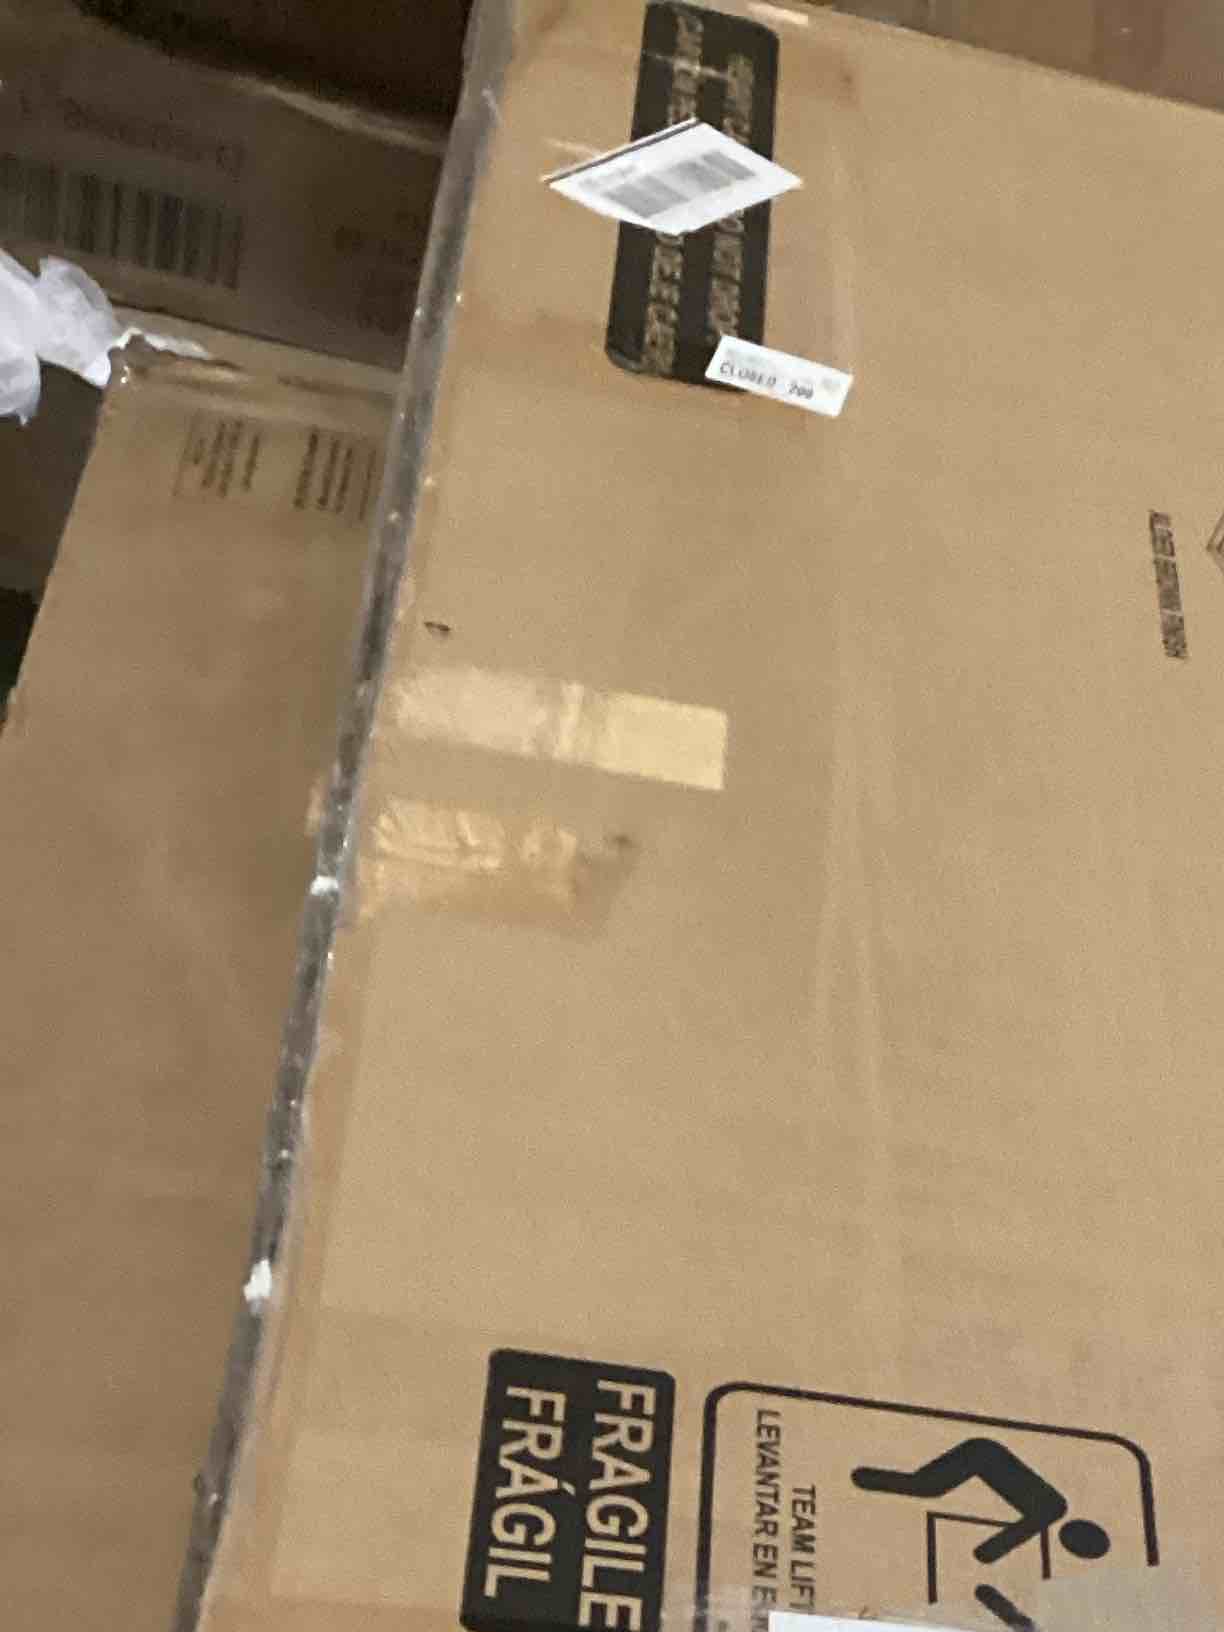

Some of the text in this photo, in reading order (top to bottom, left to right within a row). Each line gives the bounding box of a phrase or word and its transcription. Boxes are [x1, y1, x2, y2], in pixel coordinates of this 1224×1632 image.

[483, 1384, 577, 1598] FRÁGIL
[753, 1408, 782, 1535] LEVANTAR
[791, 1485, 817, 1555] TEAM
[753, 1542, 778, 1579] EN
